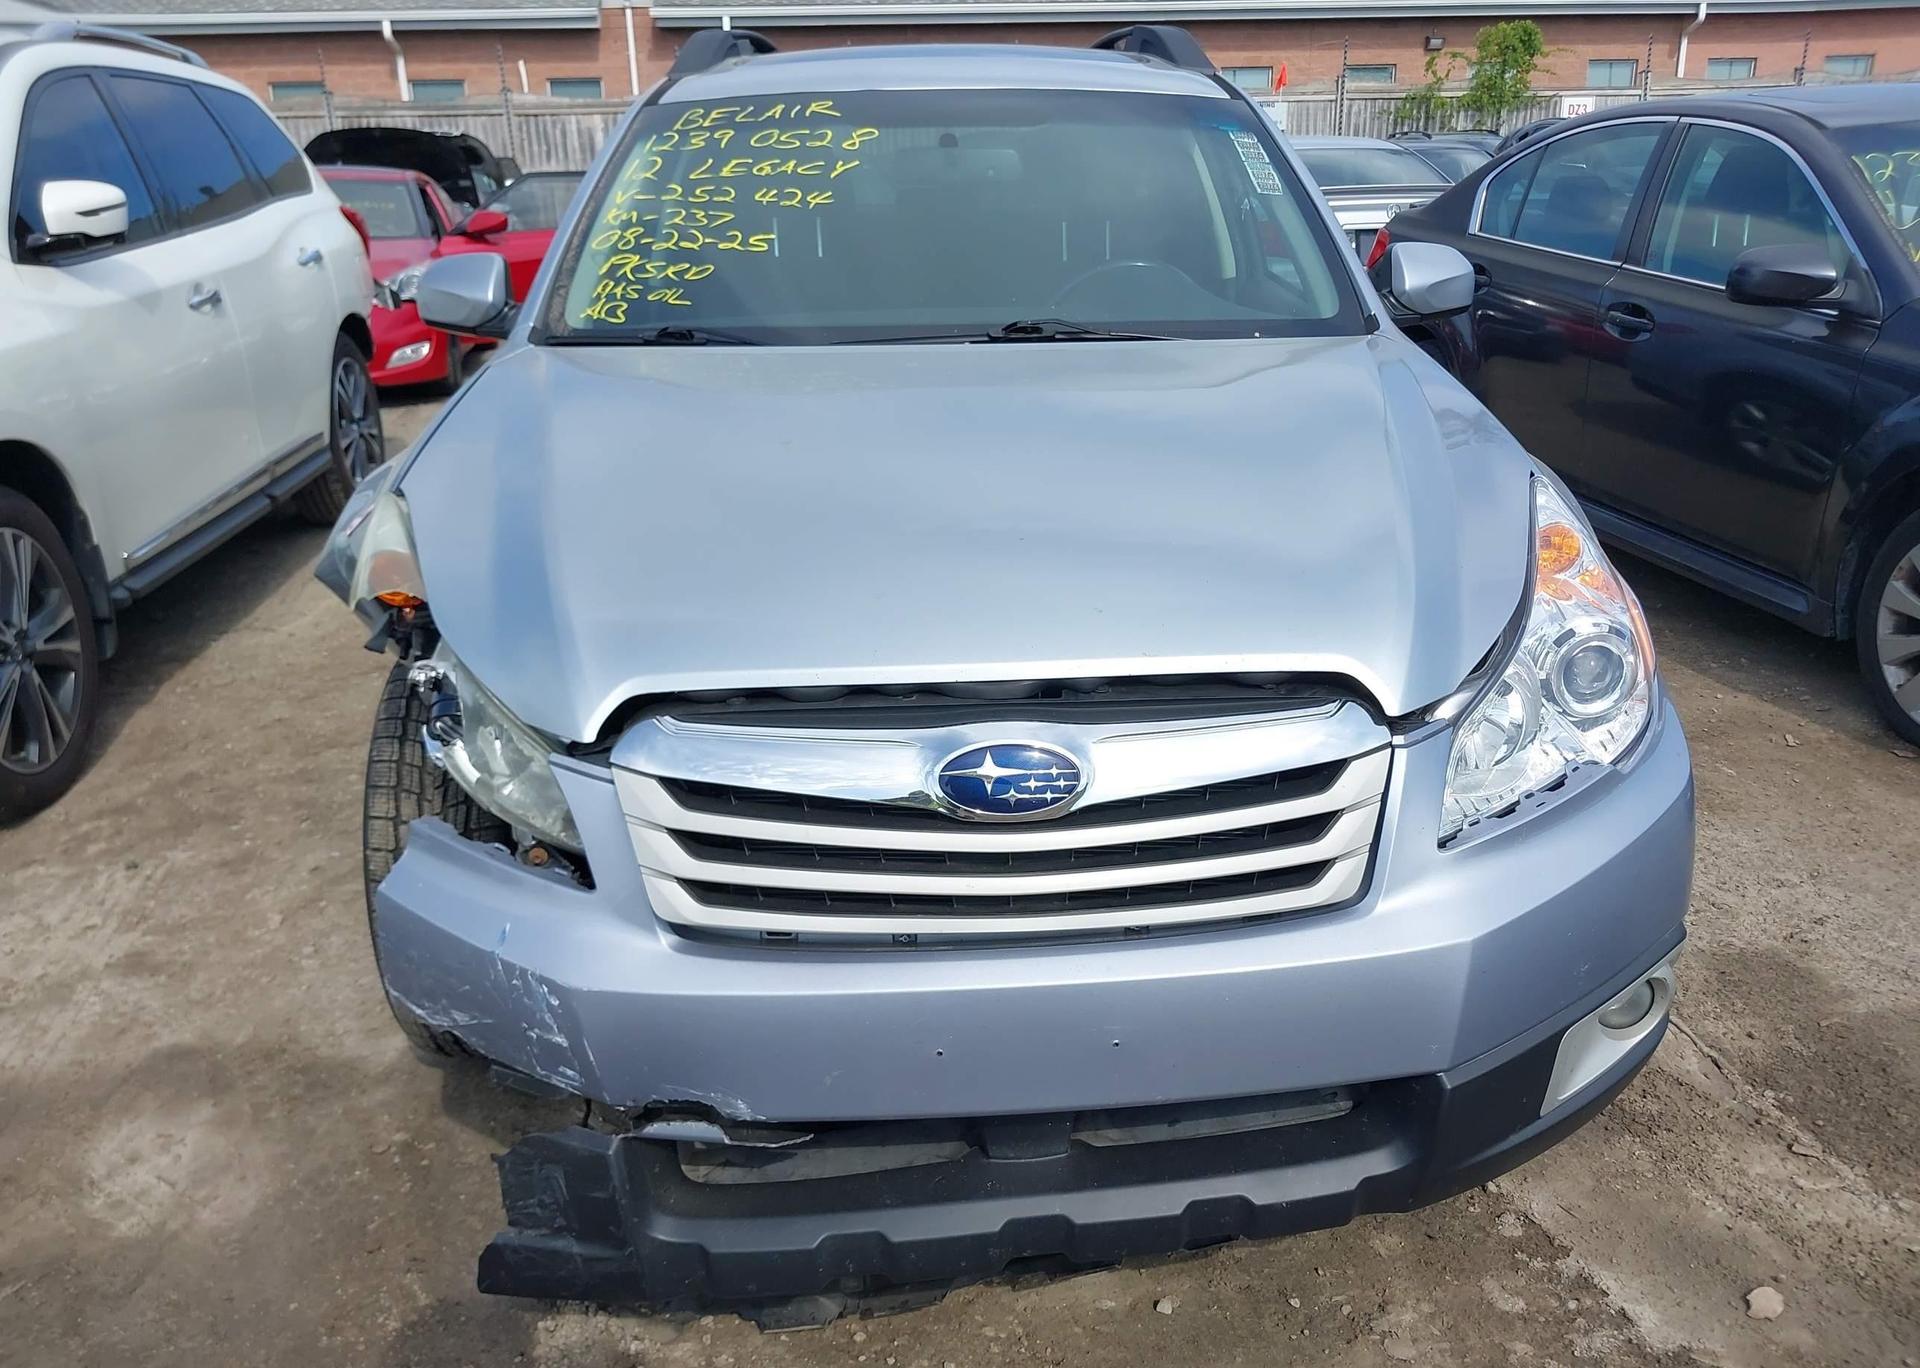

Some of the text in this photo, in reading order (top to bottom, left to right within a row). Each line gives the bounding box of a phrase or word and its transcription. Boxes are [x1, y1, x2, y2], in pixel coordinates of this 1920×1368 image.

[673, 100, 842, 131] BELAIR
[643, 127, 879, 153] 1239 0528
[623, 156, 860, 181] 12 LEGACY
[754, 187, 835, 209] 424
[591, 226, 776, 251] 08-22-25
[646, 287, 692, 305] OIL
